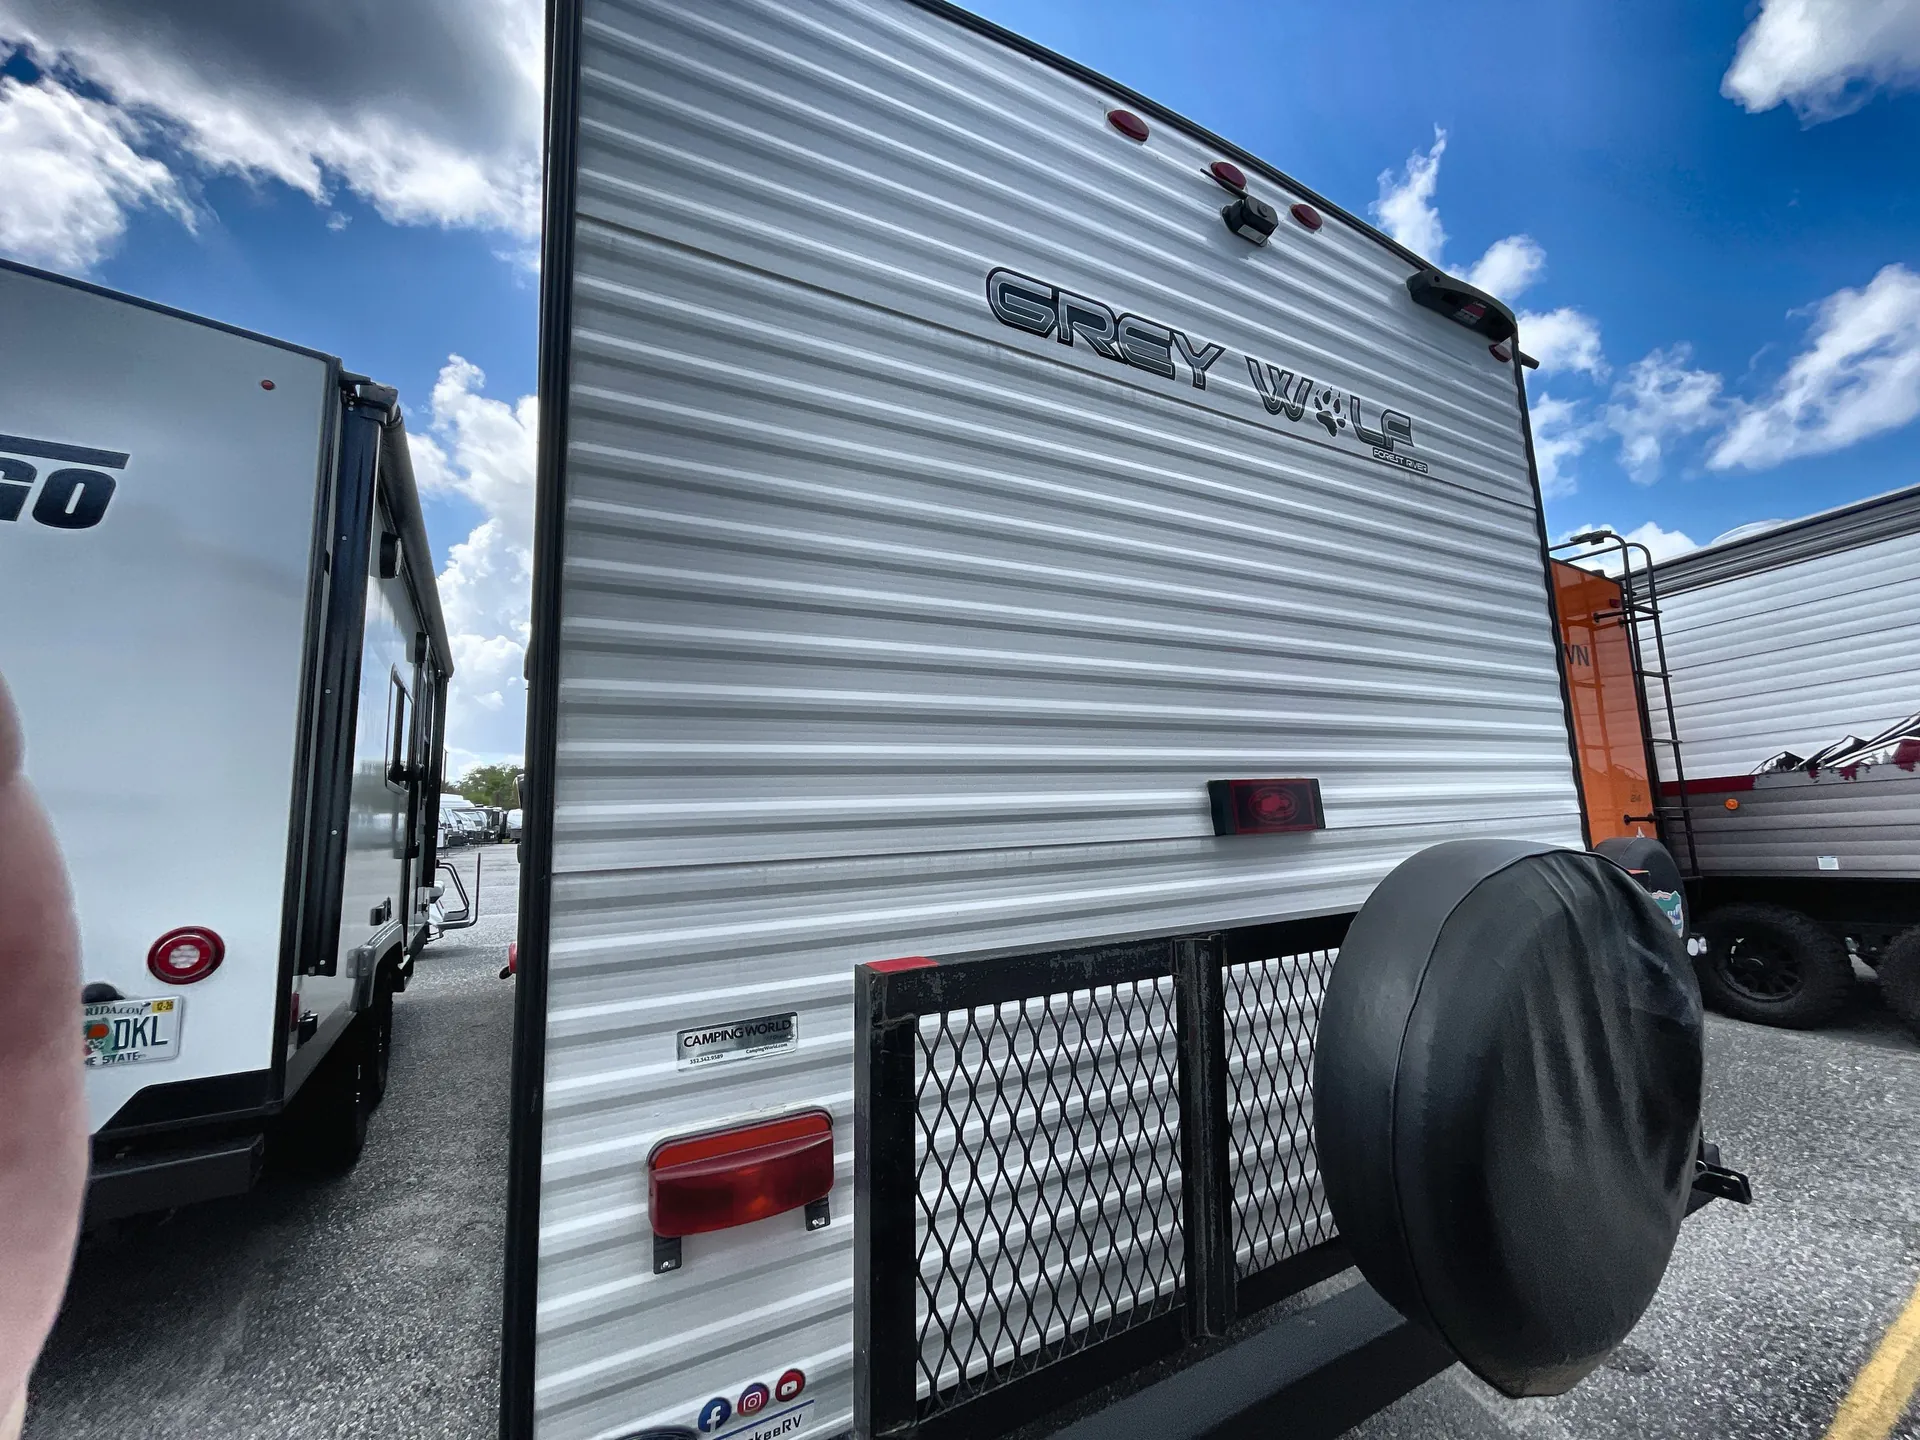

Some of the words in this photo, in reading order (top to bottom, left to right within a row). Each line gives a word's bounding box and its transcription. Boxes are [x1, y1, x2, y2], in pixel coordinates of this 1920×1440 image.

[986, 266, 1225, 390] GREY
[1373, 448, 1404, 464] FOREST
[1405, 459, 1427, 472] RIVER
[112, 1015, 170, 1051] DKL
[683, 1027, 744, 1048] CAMPING
[745, 1019, 792, 1036] WORLD
[102, 1051, 140, 1065] STATE
[745, 1042, 788, 1054] CampingWorld.com
[749, 1413, 803, 1440] keeRV
